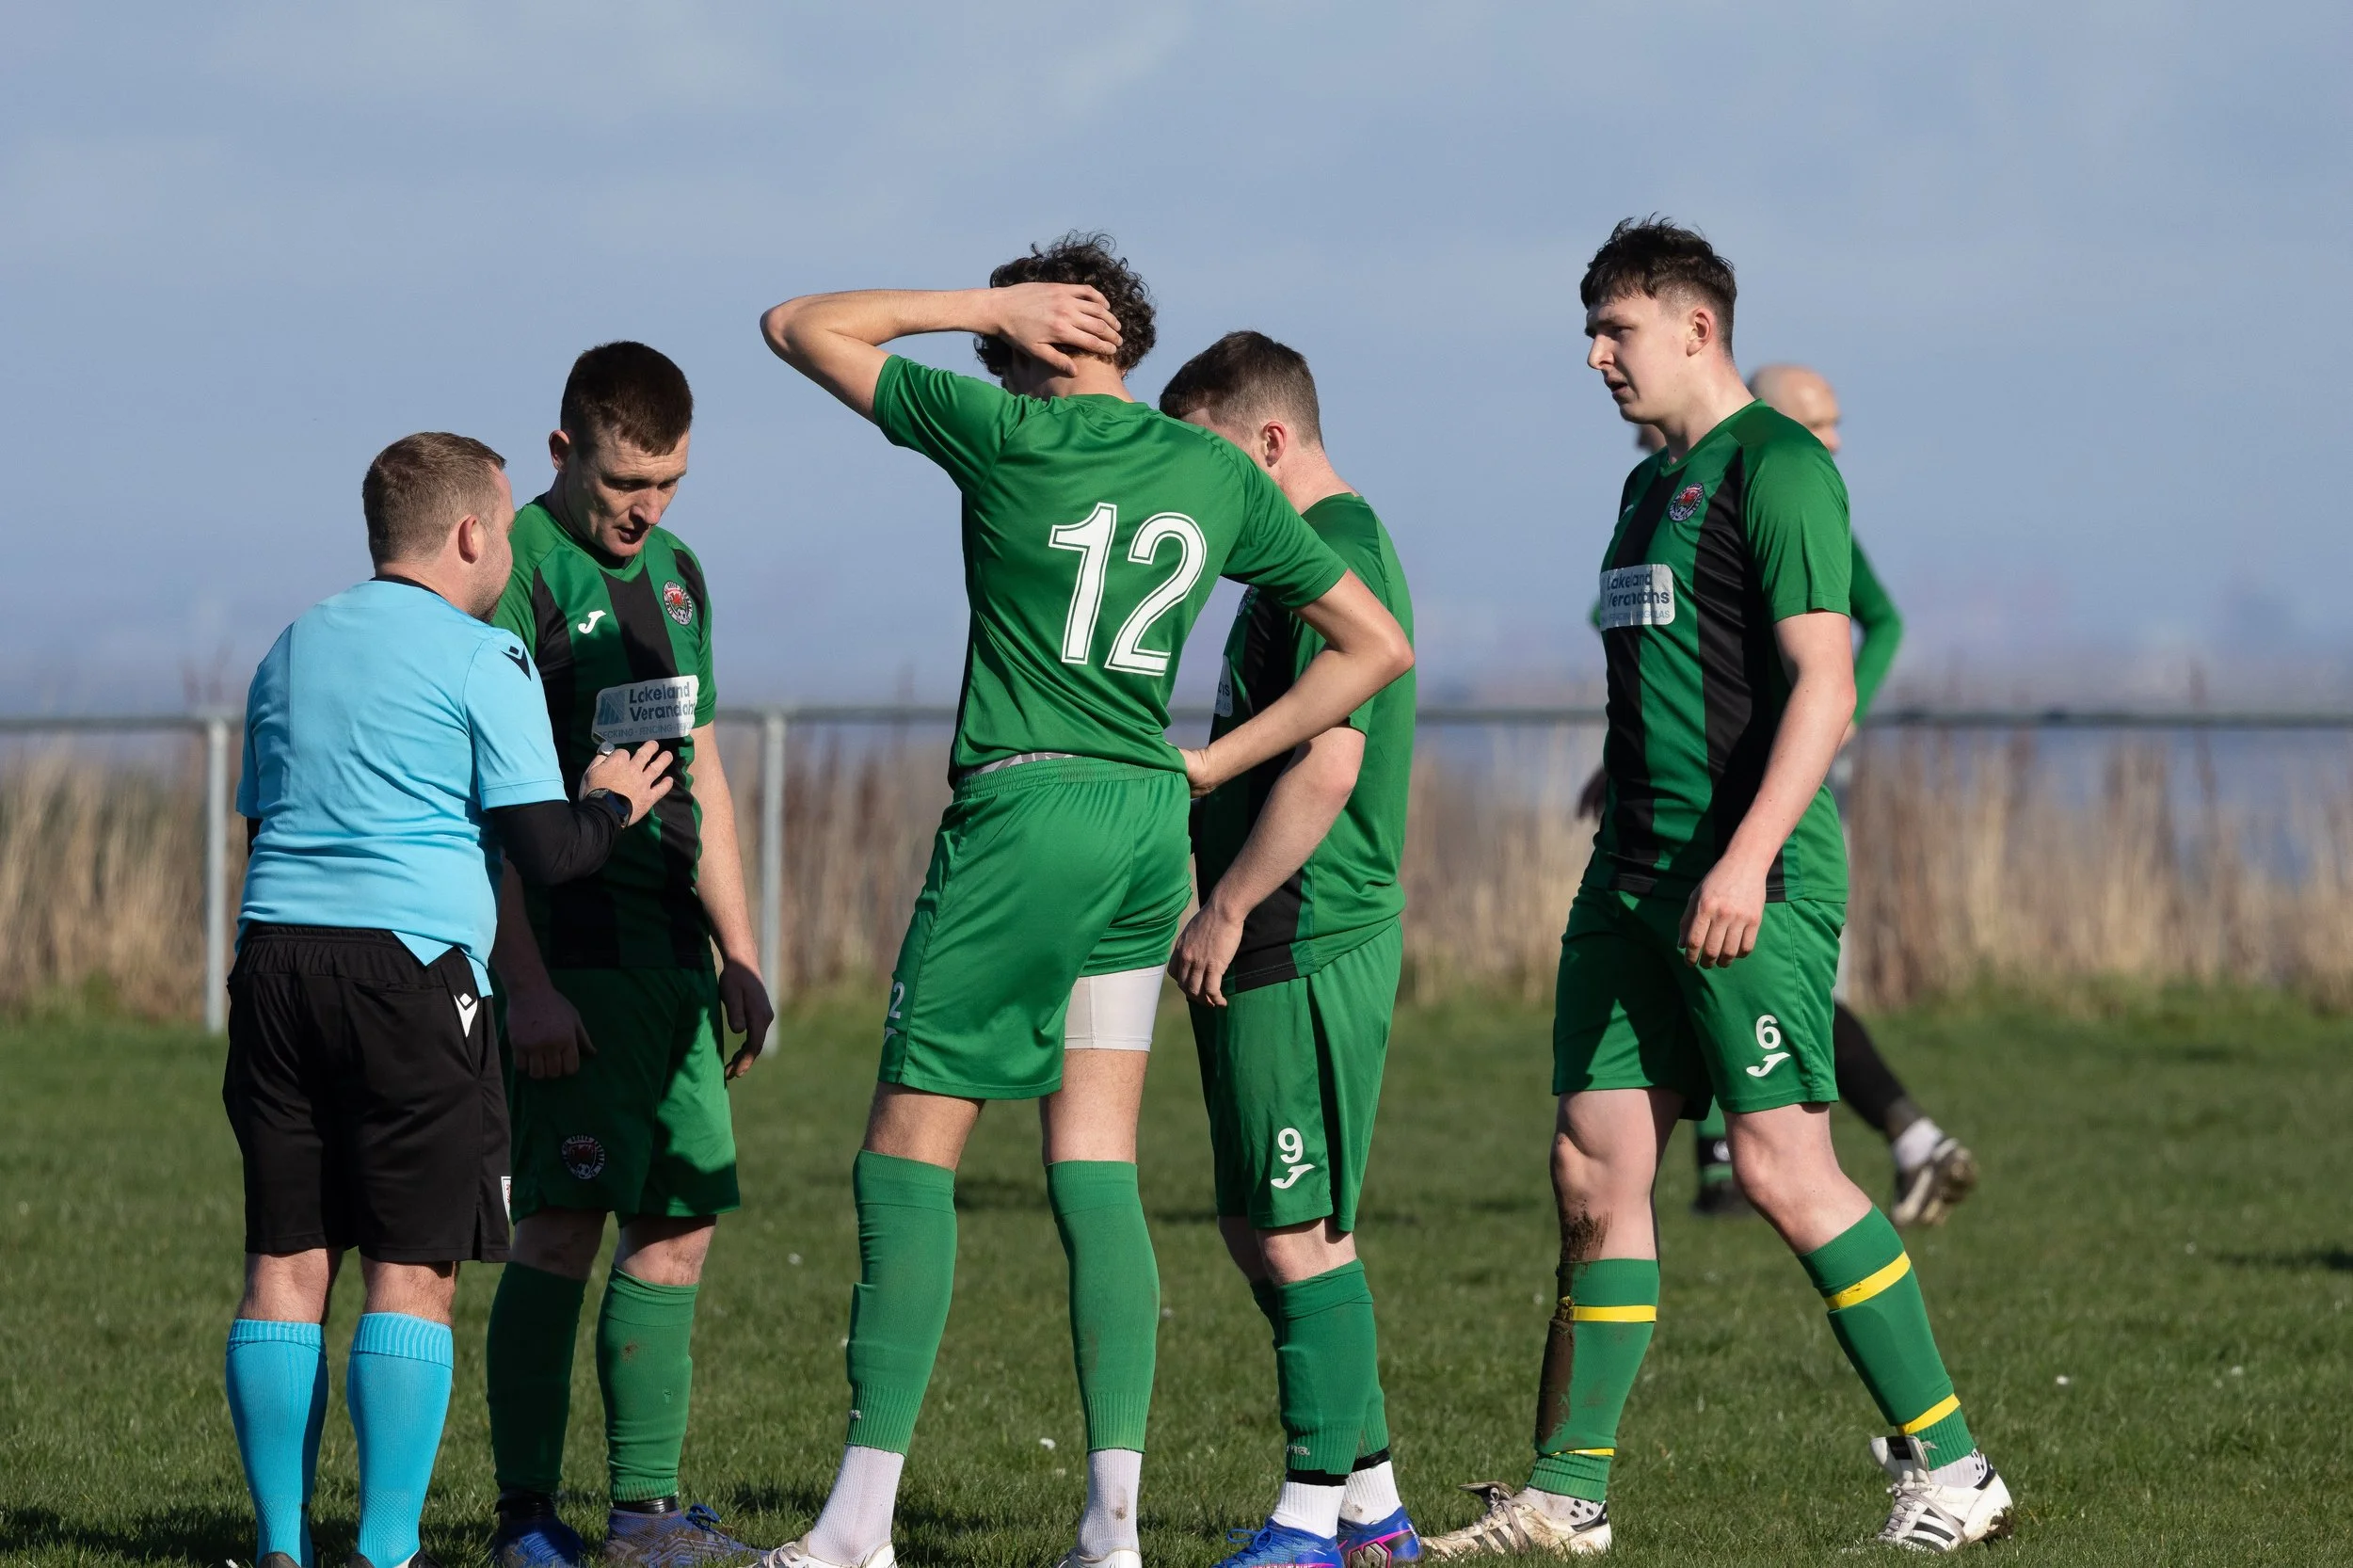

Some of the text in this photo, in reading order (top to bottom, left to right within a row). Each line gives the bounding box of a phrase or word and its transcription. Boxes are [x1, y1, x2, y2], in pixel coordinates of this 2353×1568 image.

[1048, 502, 1208, 677] 12
[629, 699, 696, 722] Verandah
[1755, 1014, 1782, 1050] 6
[1277, 1127, 1304, 1164] 9
